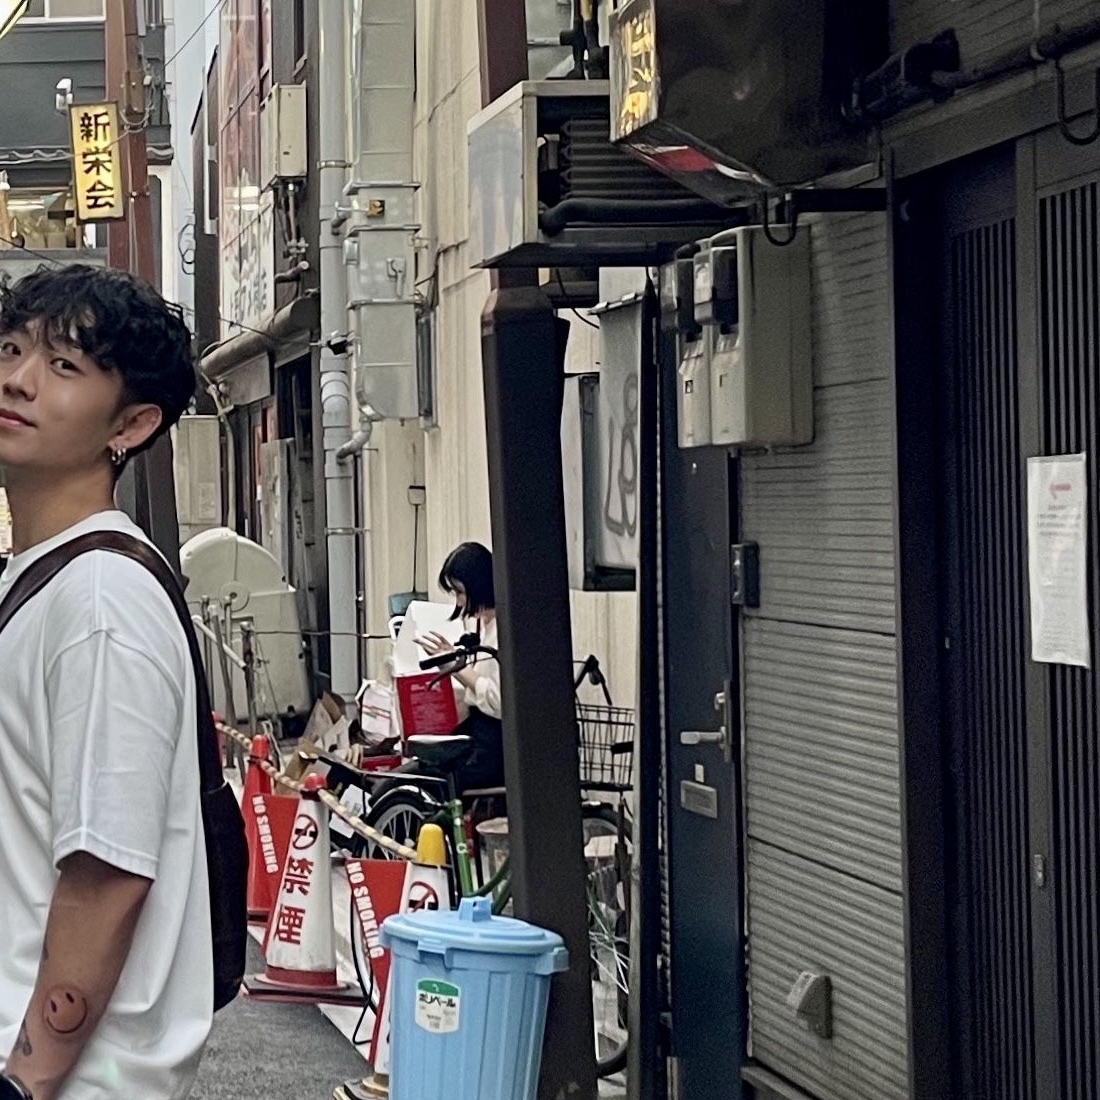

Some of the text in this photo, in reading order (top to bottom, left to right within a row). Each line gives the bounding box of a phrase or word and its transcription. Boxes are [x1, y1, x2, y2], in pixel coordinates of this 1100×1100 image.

[80, 111, 115, 210] 新栄会
[252, 795, 279, 874] NO SMOKING
[273, 855, 314, 945] 禁煙
[346, 861, 385, 959] NO SMOKING
